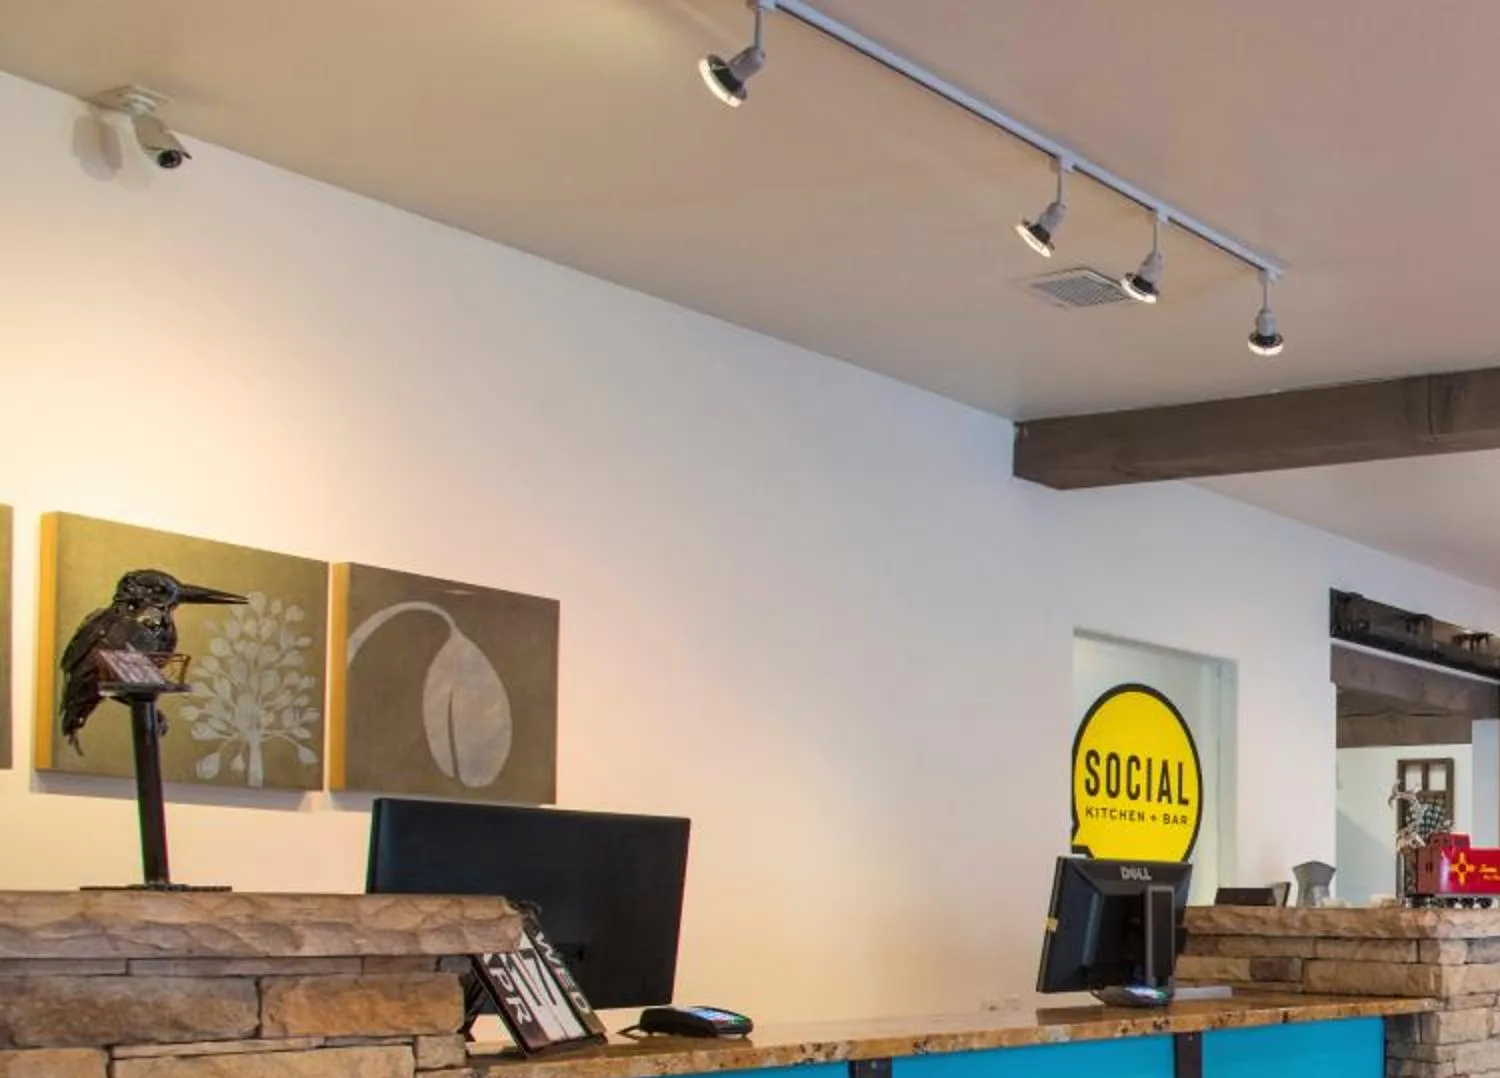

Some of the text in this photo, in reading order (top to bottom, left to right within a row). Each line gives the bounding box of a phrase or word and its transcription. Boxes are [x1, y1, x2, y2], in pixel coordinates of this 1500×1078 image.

[1085, 749, 1190, 807] SOCIAL
[1085, 806, 1145, 823] KITCHEN
[1163, 813, 1189, 826] BAR
[1120, 865, 1153, 881] DELL
